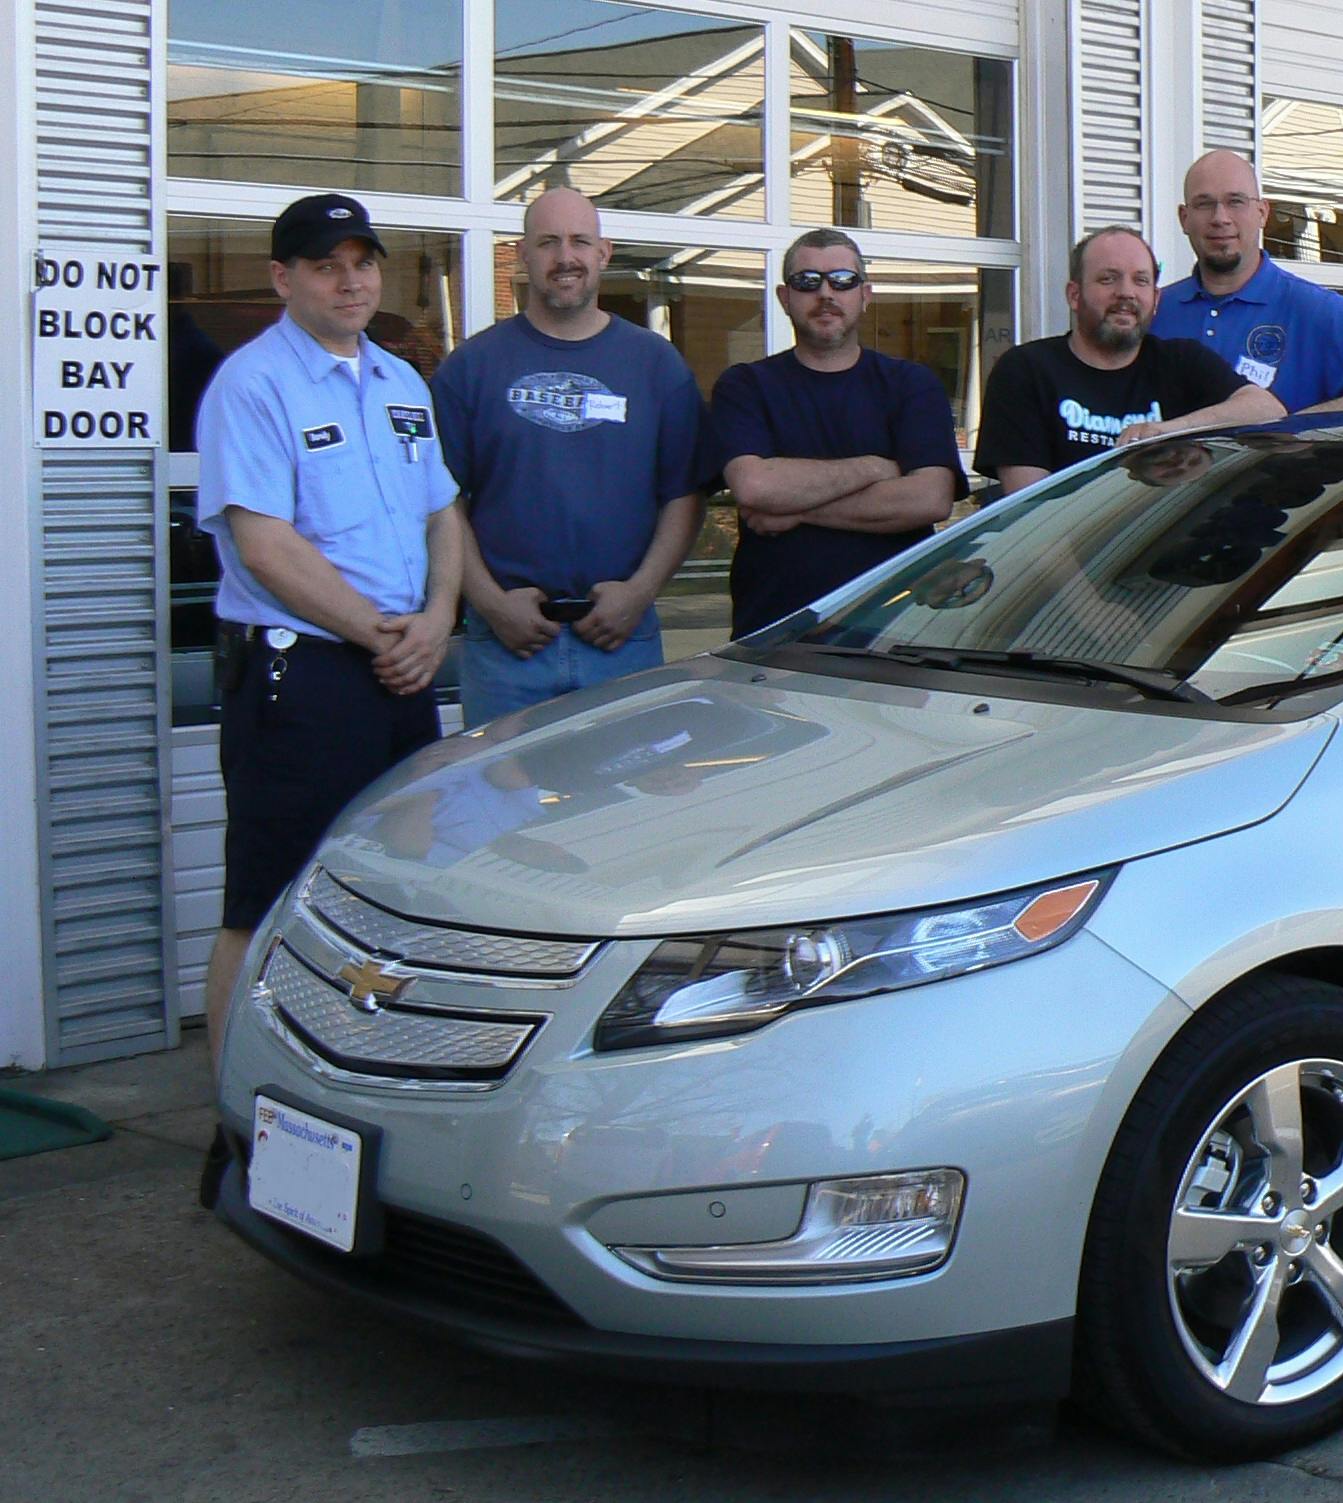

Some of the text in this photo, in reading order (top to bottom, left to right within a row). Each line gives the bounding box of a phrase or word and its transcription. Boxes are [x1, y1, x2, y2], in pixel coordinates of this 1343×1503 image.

[35, 259, 160, 291] DO NOT
[39, 309, 157, 340] BLOCK
[61, 360, 134, 389] BAY
[44, 411, 150, 439] DOOR
[1068, 430, 1116, 446] RESTA
